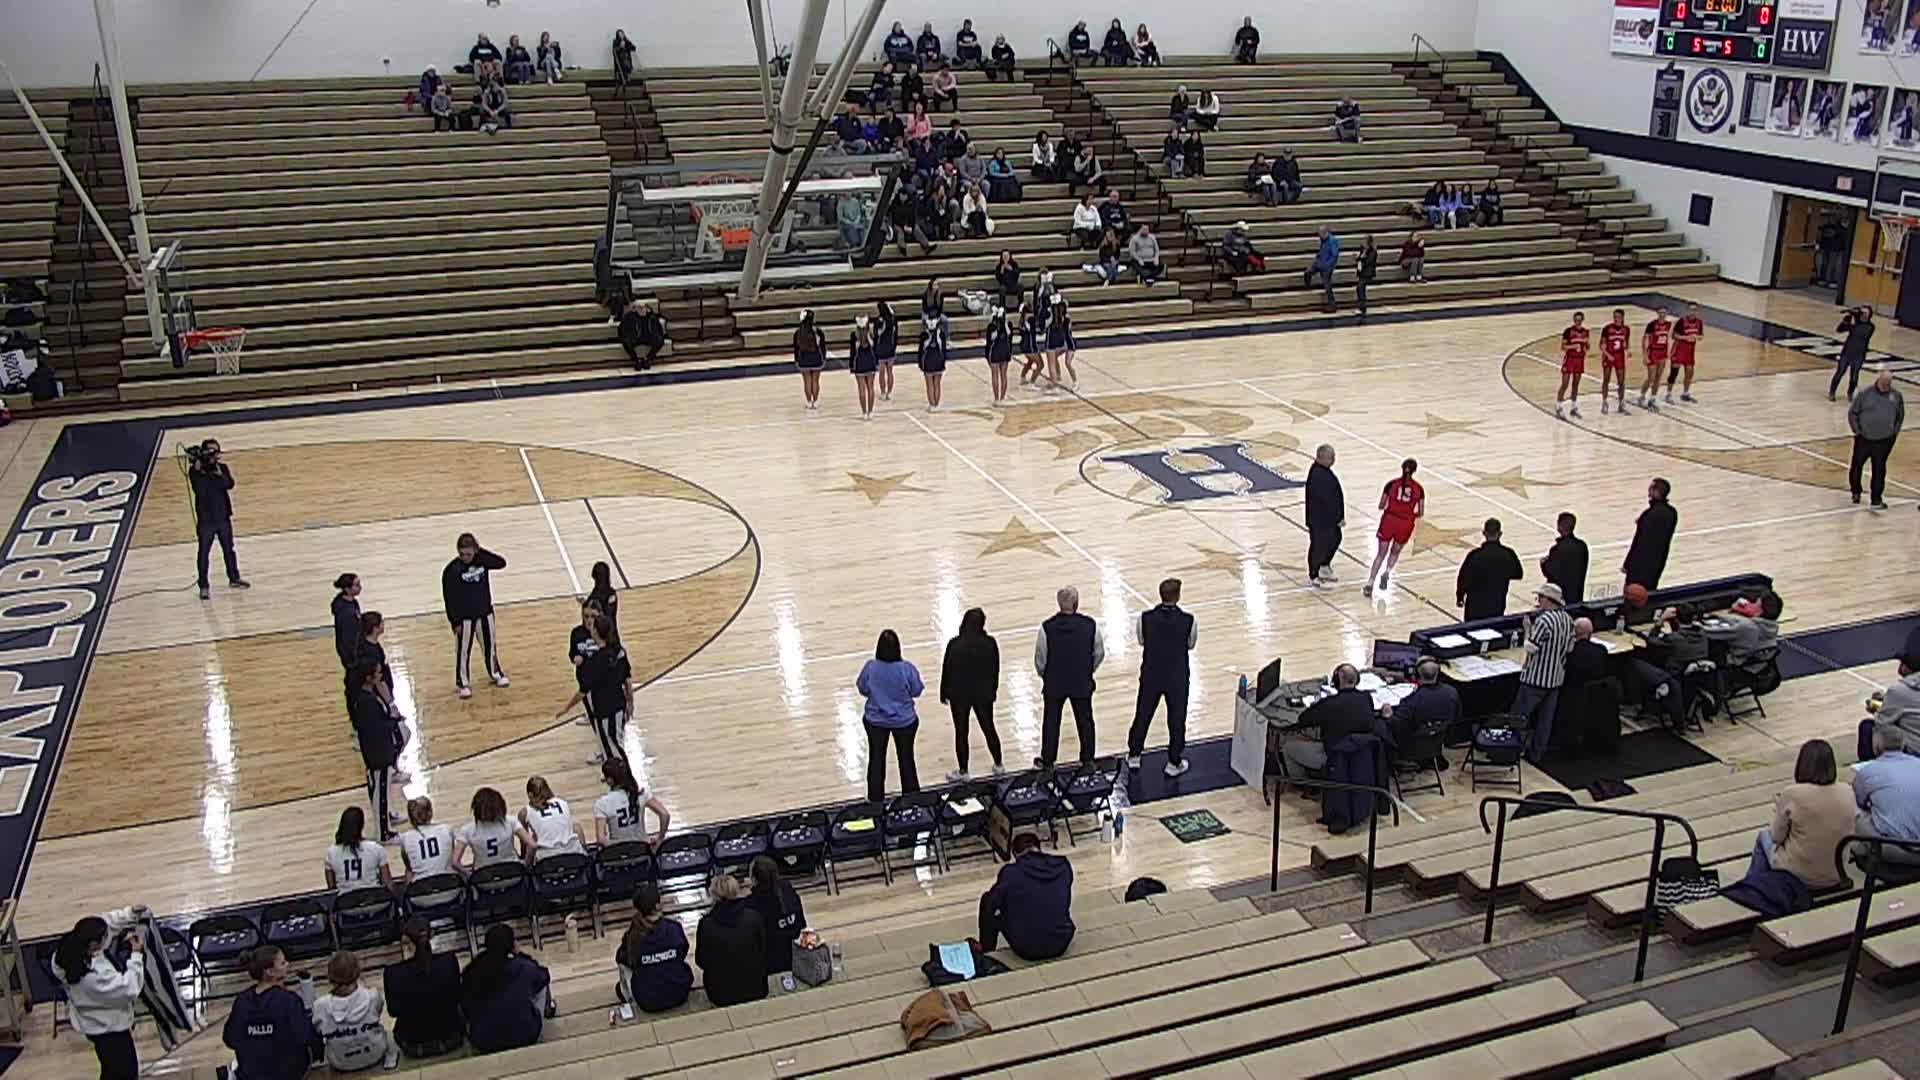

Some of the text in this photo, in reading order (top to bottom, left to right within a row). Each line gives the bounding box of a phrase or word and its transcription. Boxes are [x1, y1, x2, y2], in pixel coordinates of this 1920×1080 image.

[1676, 2, 1686, 19] 0
[1760, 7, 1770, 25] 0
[1667, 37, 1674, 50] 0
[1693, 37, 1702, 52] 5
[1724, 40, 1732, 54] 5
[1781, 29, 1825, 54] HW
[1757, 44, 1766, 58] 0
[0, 470, 138, 818] PLORERS
[418, 837, 440, 860] 10
[486, 838, 499, 857] 5
